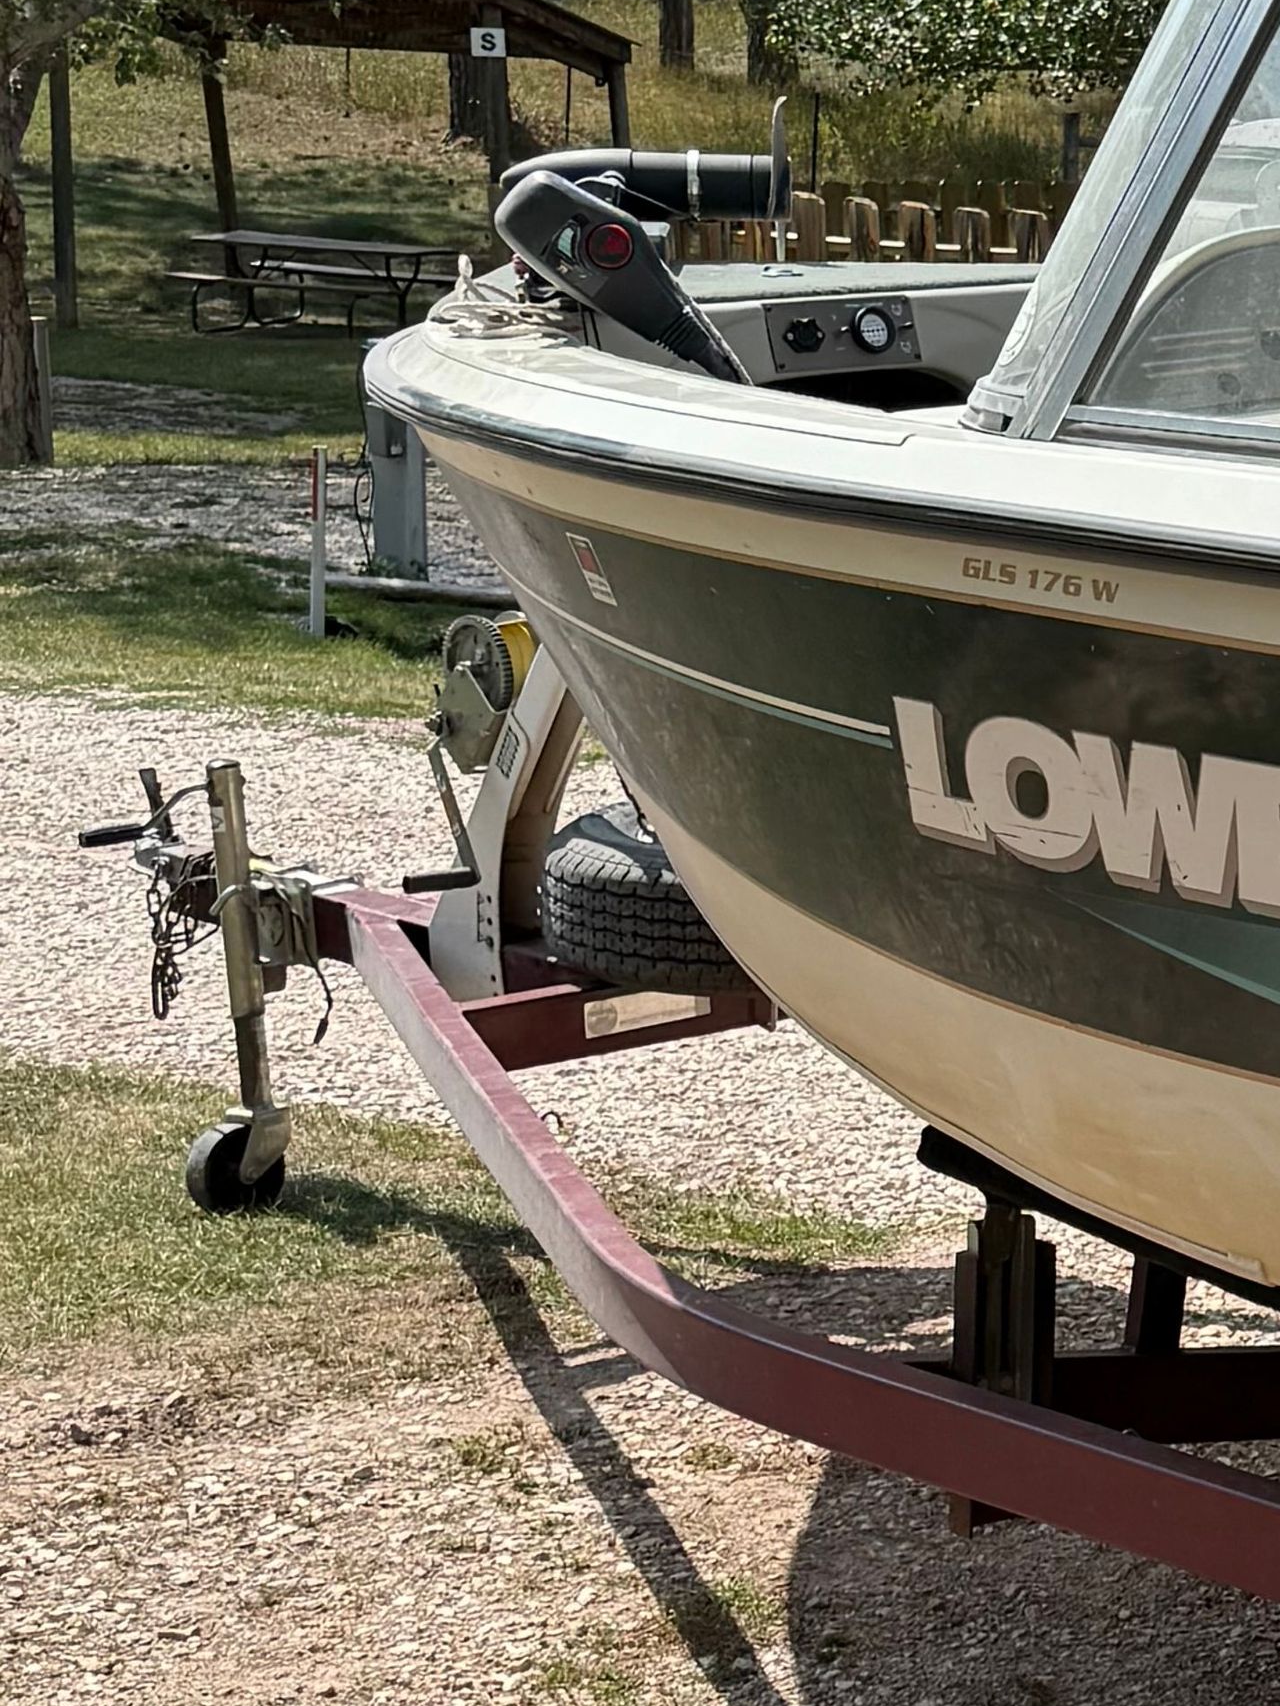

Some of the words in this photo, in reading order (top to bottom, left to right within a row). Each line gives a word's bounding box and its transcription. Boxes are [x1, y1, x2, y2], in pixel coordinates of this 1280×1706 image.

[481, 32, 496, 51] S
[962, 557, 1016, 585] GLS
[1028, 569, 1082, 597] 176
[1092, 579, 1119, 604] W
